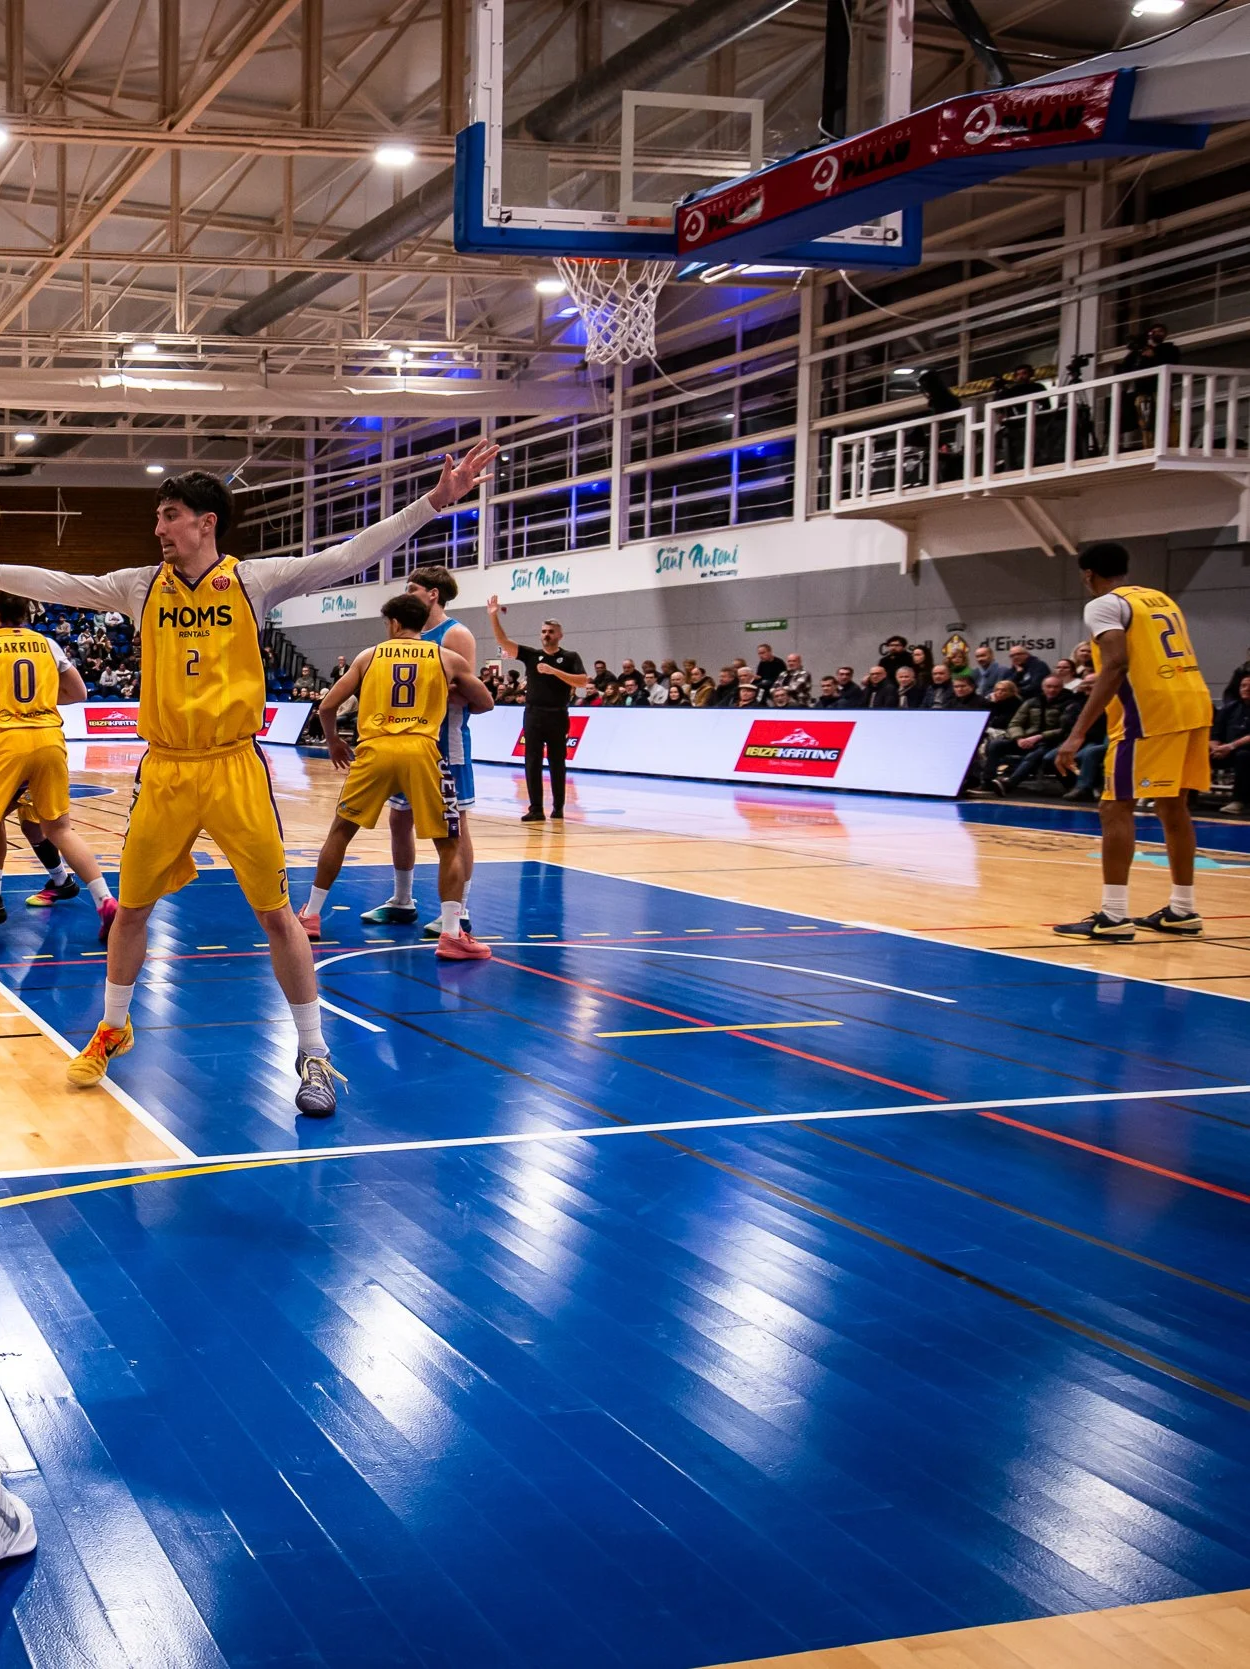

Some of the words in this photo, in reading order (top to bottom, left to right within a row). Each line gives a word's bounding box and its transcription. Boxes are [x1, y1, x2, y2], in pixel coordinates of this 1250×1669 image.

[842, 127, 912, 158] SERVICIOS
[655, 547, 686, 574] Sant
[178, 630, 211, 638] RENTALS
[186, 649, 200, 676] 2
[377, 647, 435, 659] JUANOLA
[13, 658, 36, 703] 0
[391, 663, 418, 708] 8
[745, 746, 839, 760] IBIZAKARTING
[278, 868, 288, 895] 2
